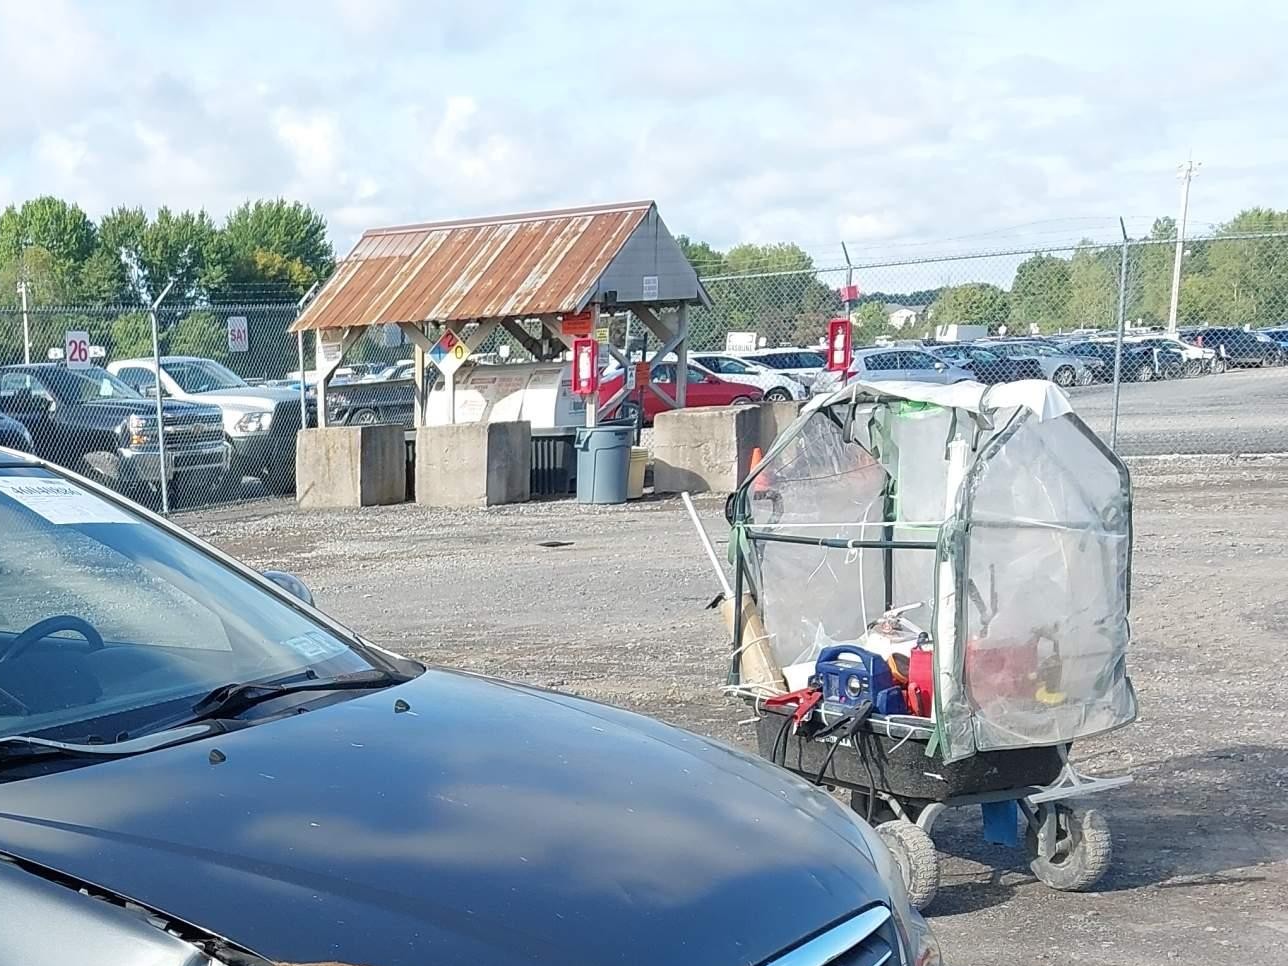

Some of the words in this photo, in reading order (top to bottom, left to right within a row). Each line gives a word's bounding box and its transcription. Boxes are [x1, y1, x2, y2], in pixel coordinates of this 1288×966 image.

[446, 332, 455, 348] 2
[68, 340, 88, 362] 26
[454, 345, 464, 360] 0
